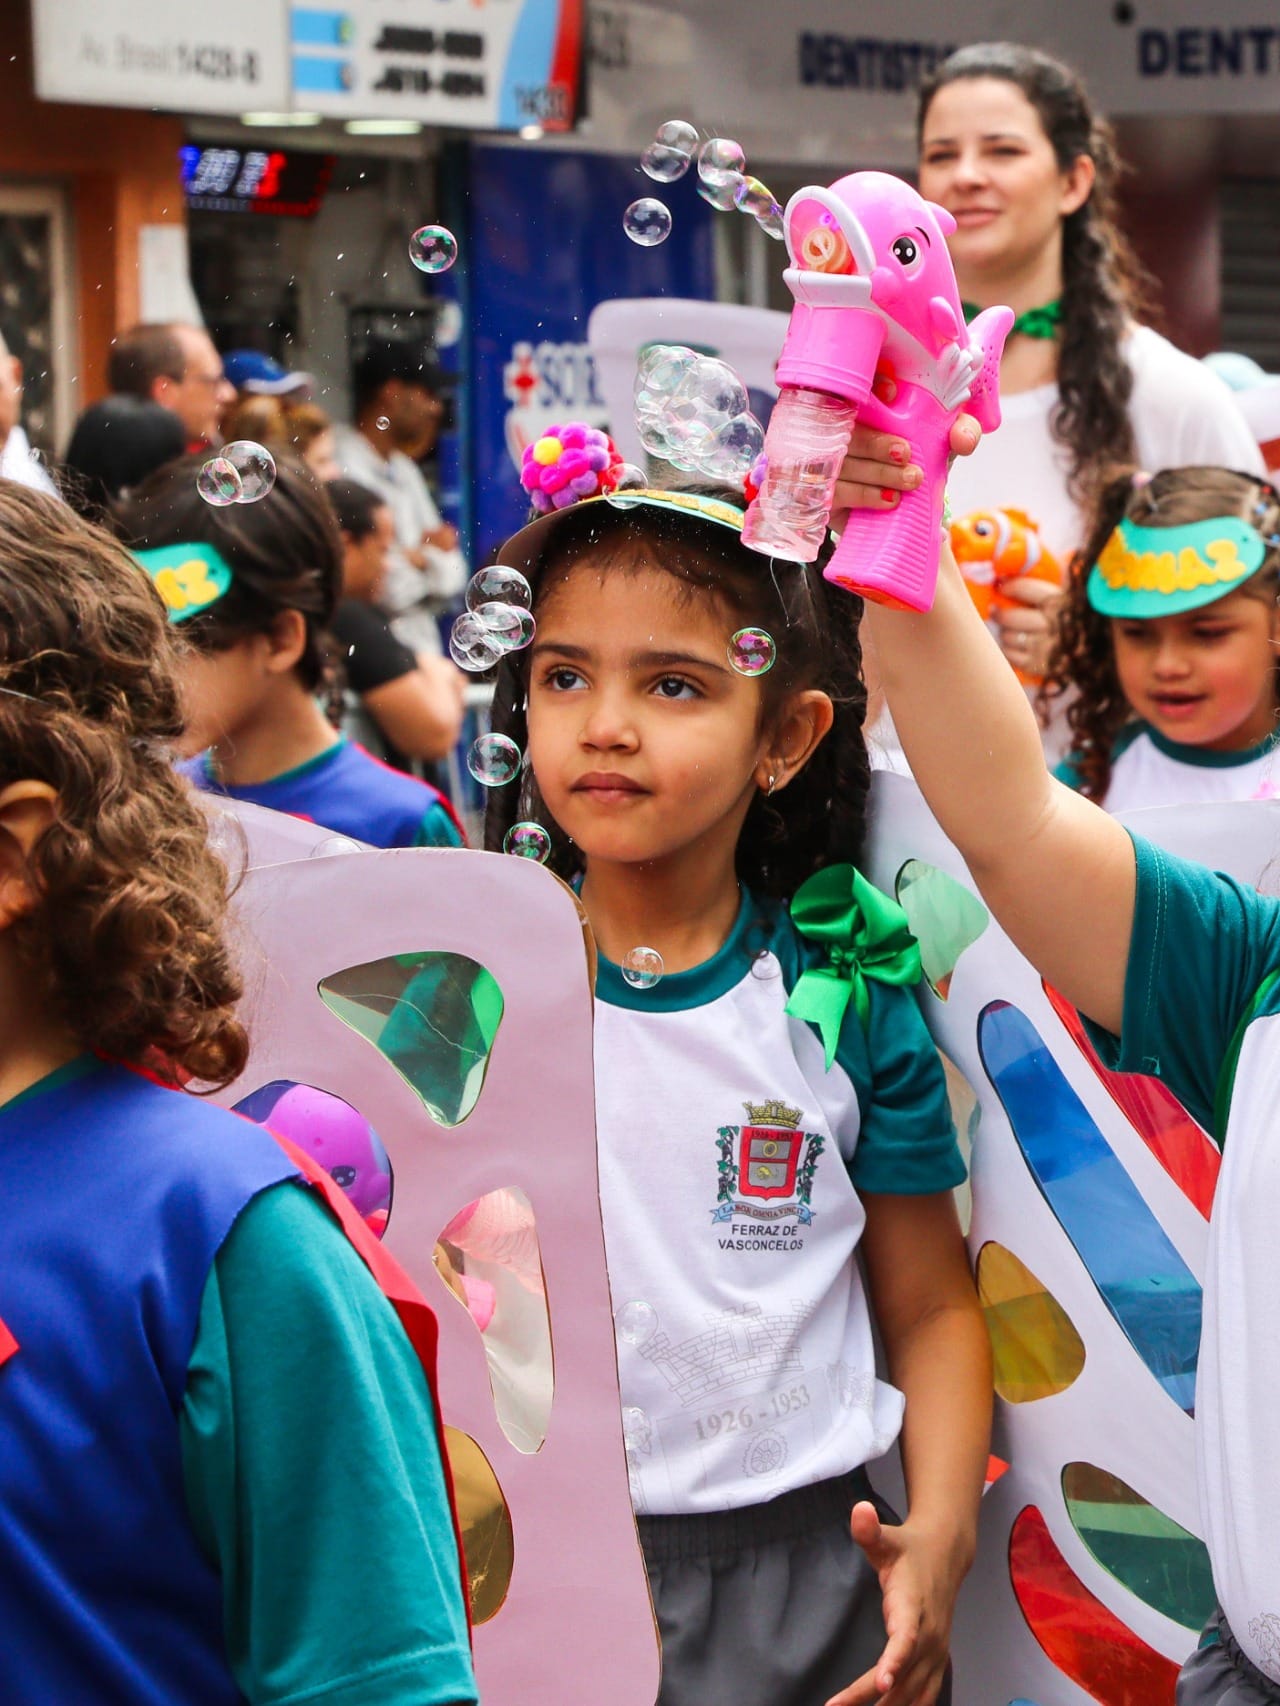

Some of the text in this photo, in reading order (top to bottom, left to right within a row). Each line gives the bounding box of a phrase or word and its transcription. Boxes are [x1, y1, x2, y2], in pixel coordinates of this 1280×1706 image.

[732, 1224, 798, 1236] FERRAZ DE
[718, 1239, 803, 1251] VASCONCELOS
[694, 1404, 753, 1441] 1926
[771, 1384, 810, 1418] 1953
